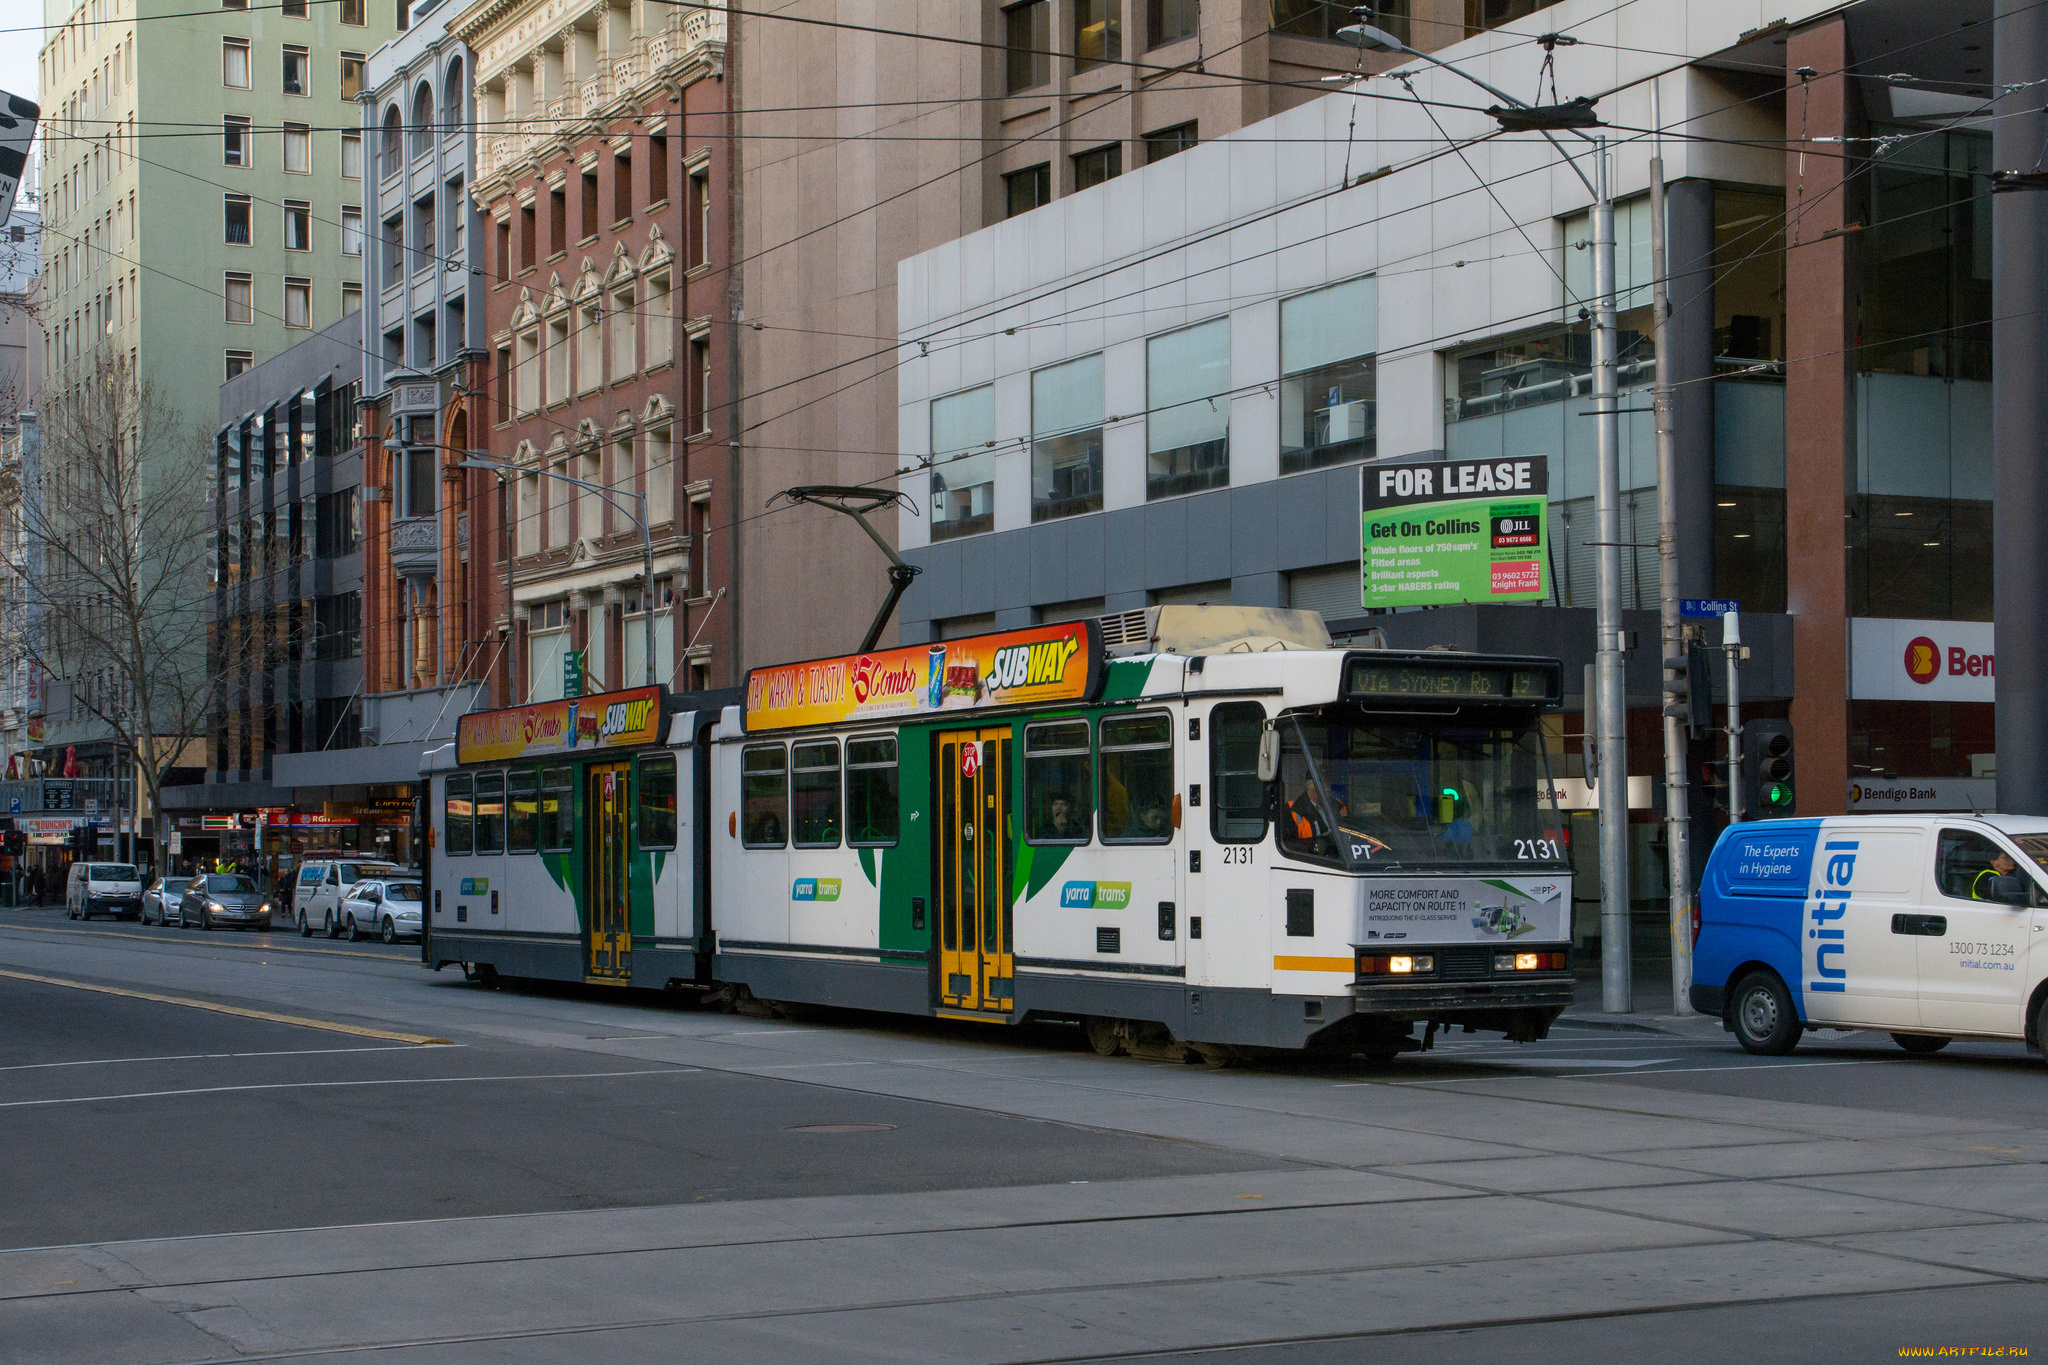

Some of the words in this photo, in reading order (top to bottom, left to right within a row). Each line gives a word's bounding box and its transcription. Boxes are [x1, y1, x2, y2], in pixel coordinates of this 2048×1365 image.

[1379, 467, 1433, 498] FOR
[1442, 461, 1532, 495] LEASE
[1371, 522, 1397, 538] Get
[1401, 521, 1421, 537] On
[1425, 518, 1480, 536] Collins
[1513, 520, 1531, 531] JLL
[1371, 545, 1396, 555] Whole
[1399, 544, 1423, 554] floors
[1425, 543, 1434, 552] of
[1371, 558, 1395, 567] Fitted
[1397, 558, 1421, 567] areas
[1371, 570, 1404, 580] Brilliant
[1406, 569, 1439, 580] aspects
[1502, 572, 1520, 580] 9602
[1371, 583, 1396, 593] 3-star
[1398, 581, 1432, 591] NABERS
[1434, 580, 1460, 591] rating
[1492, 581, 1516, 589] Knight
[1518, 579, 1539, 587] Frank
[1700, 600, 1727, 612] Collins
[1729, 600, 1738, 612] St
[986, 634, 1078, 692] SUBWAY
[1948, 646, 1995, 677] Ben
[768, 669, 795, 710] WARM
[797, 668, 805, 707] &
[808, 663, 846, 705] TOASTY!
[870, 656, 917, 697] Combo
[1358, 673, 1389, 692] VIA
[1400, 669, 1461, 693] SYDNEY
[602, 695, 655, 737] SUBWAY
[533, 710, 562, 739] Combo
[964, 746, 976, 757] STOP
[1864, 787, 1908, 802] Bendigo
[1909, 787, 1937, 799] Bank
[10, 797, 19, 808] P
[40, 819, 73, 831] DUNCAN'S
[1223, 846, 1254, 865] 2131
[1514, 838, 1561, 860] 2131
[1743, 844, 1761, 857] The
[1763, 844, 1799, 860] Experts
[1739, 861, 1749, 874] in
[1751, 862, 1792, 878] Hygiene
[795, 882, 813, 896] yarra
[818, 881, 838, 895] trams
[1065, 886, 1090, 902] yarra
[1097, 884, 1126, 902] trams
[1369, 889, 1398, 900] MORE
[1399, 889, 1438, 900] COMFORT
[1440, 889, 1459, 899] AND
[1369, 901, 1413, 911] CAPACITY
[1413, 901, 1426, 911] ON
[1427, 901, 1455, 911] ROUTE
[1458, 901, 1466, 911] 11
[1809, 840, 1860, 993] Initial
[1949, 941, 1974, 955] 1300
[1975, 942, 1988, 955] 73
[1990, 943, 2015, 957] 1234
[1959, 958, 2015, 972] initial.com.au
